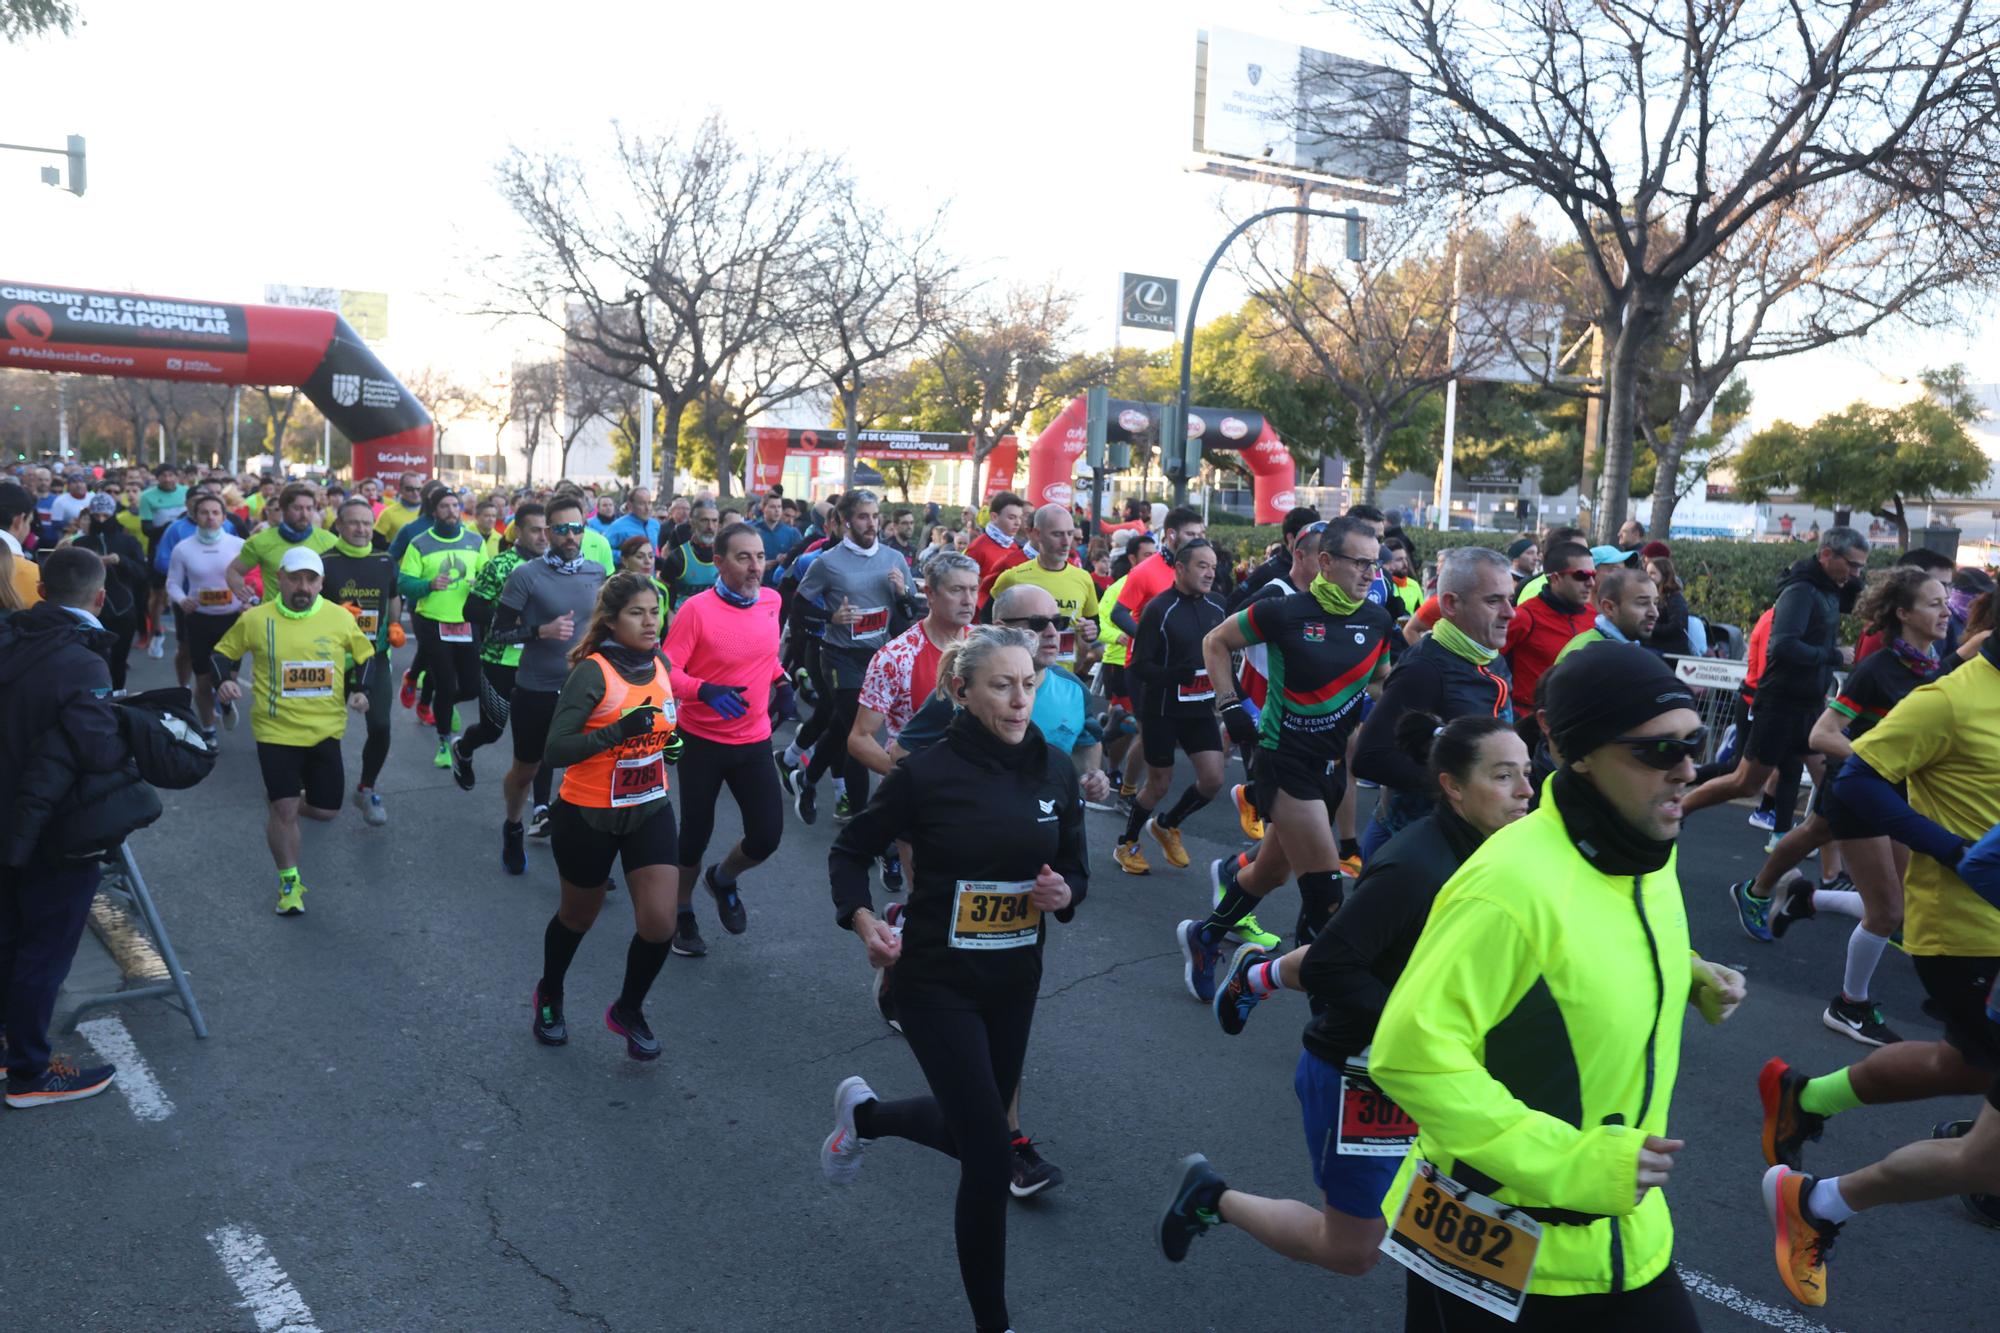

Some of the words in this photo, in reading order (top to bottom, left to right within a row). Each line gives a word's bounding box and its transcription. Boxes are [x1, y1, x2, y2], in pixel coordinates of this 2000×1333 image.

[1, 286, 84, 306] CIRCUIT
[88, 296, 117, 310] DE
[119, 298, 227, 320] CARRERES
[67, 306, 230, 334] CAIXAPOPULAR
[1126, 311, 1174, 325] LEXUS
[880, 433, 920, 442] CARRERES
[289, 668, 326, 682] 3403
[1285, 713, 1303, 725] THE
[1304, 711, 1341, 726] KENYAN
[1340, 691, 1363, 715] URBAN
[622, 766, 656, 787] 2785
[971, 895, 1028, 922] 3734
[1358, 1095, 1414, 1125] 307
[1414, 1187, 1513, 1269] 3682
